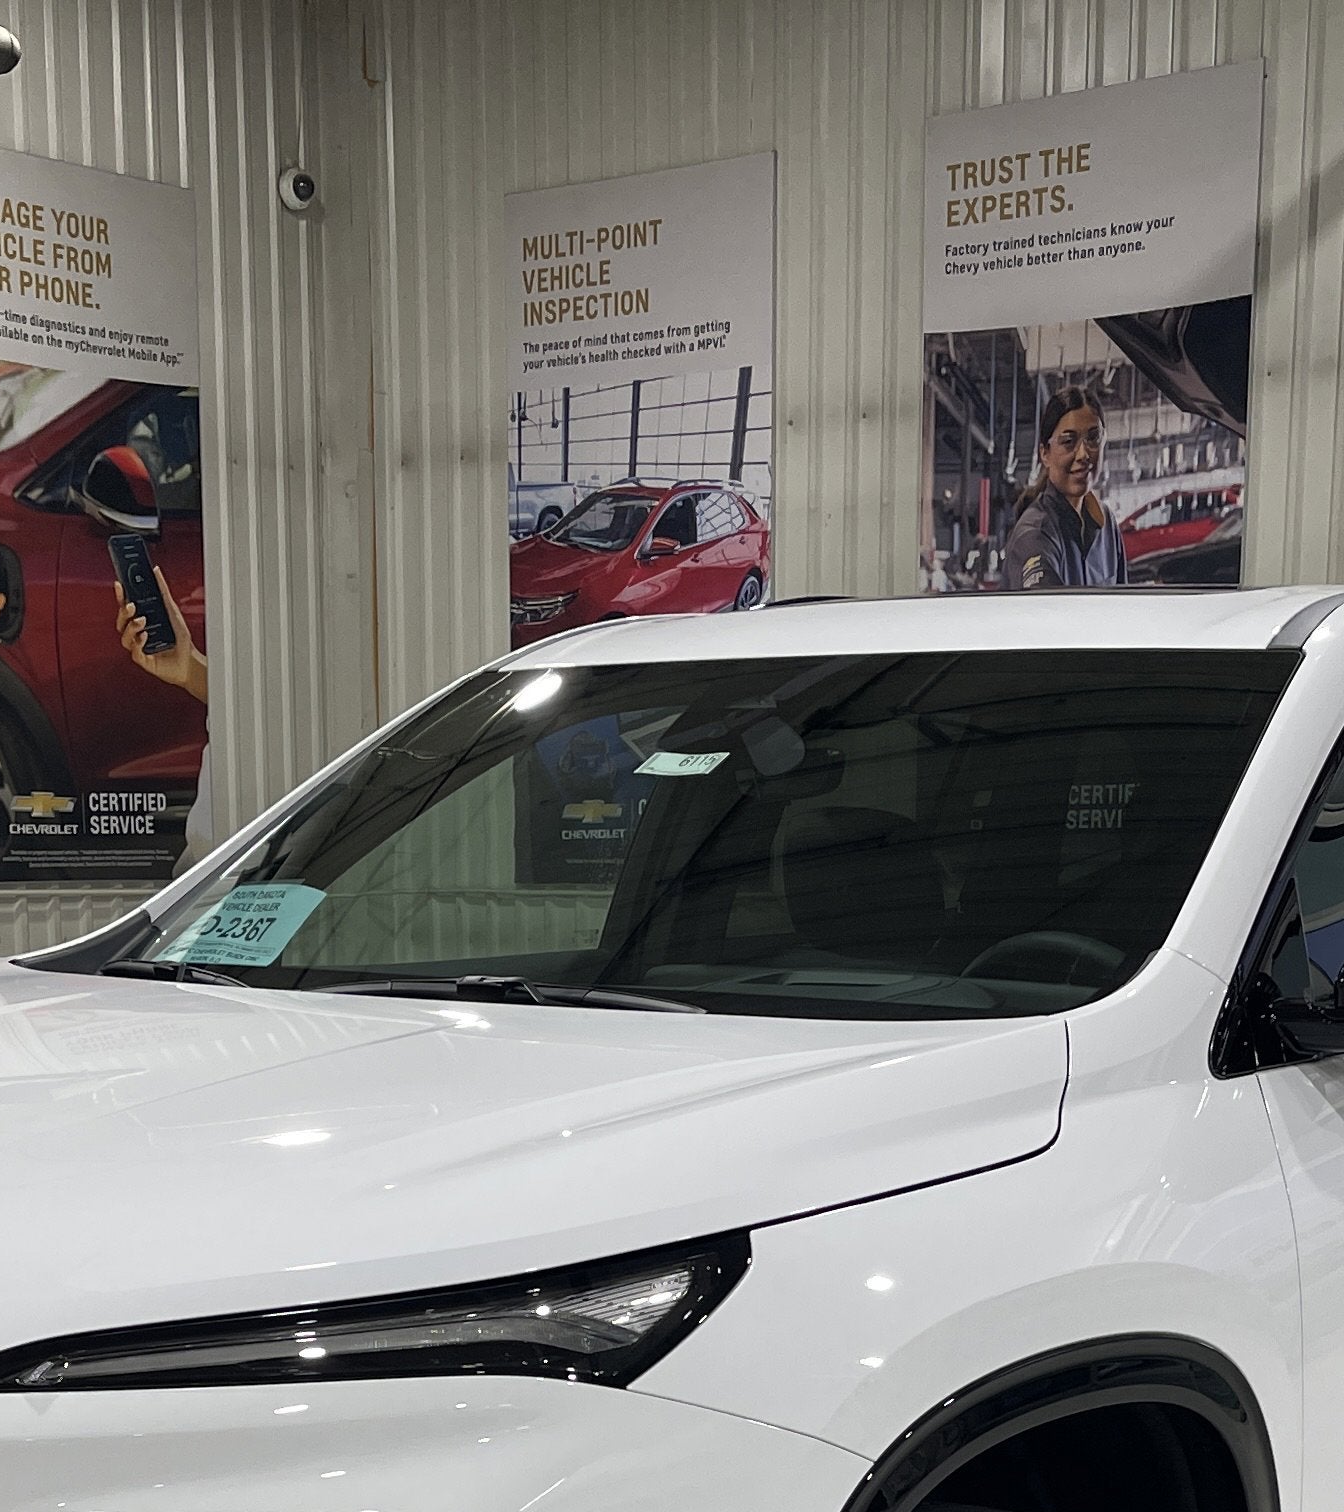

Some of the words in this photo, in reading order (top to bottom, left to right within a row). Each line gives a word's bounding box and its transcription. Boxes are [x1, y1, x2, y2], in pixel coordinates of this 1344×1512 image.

[946, 153, 1031, 192] TRUST
[1038, 143, 1092, 178] THE
[946, 184, 1075, 228] EXPERTS.
[51, 207, 111, 246] YOUR
[522, 218, 663, 262] MULTI-POINT
[945, 240, 990, 259] Factory
[992, 234, 1035, 252] trained
[1038, 226, 1107, 247] technicians
[1110, 222, 1144, 237] know
[1146, 215, 1176, 234] your
[53, 243, 112, 279] FROM
[945, 260, 980, 277] Chevy
[982, 255, 1024, 272] vehicle
[1026, 250, 1064, 267] better
[1067, 246, 1095, 262] than
[1097, 239, 1146, 259] anyone.
[19, 270, 102, 310] PHONE.
[522, 258, 611, 295] VEHICLE
[523, 287, 650, 328] INSPECTION
[29, 313, 86, 336] diagnostics
[88, 321, 106, 339] and
[108, 327, 134, 346] enjoy
[135, 332, 169, 348] remote
[31, 333, 44, 346] on
[46, 335, 63, 348] the
[64, 340, 126, 360] myChevrolet
[127, 349, 158, 362] Mobile
[523, 341, 540, 354] The
[542, 338, 570, 355] peace
[572, 336, 583, 348] of
[584, 333, 608, 347] mind
[610, 330, 631, 345] that
[632, 329, 665, 342] comes
[666, 324, 691, 338] from
[693, 320, 731, 338] getting
[522, 358, 545, 374] your
[546, 351, 587, 369] vehicle's
[588, 349, 619, 364] health
[621, 343, 662, 361] checked
[664, 341, 687, 355] with
[688, 342, 696, 352] a
[88, 792, 167, 813] CERTIFIED
[9, 824, 79, 835] CHEVROLET
[89, 815, 155, 835] SERVICE
[561, 828, 626, 840] CHEVROLET
